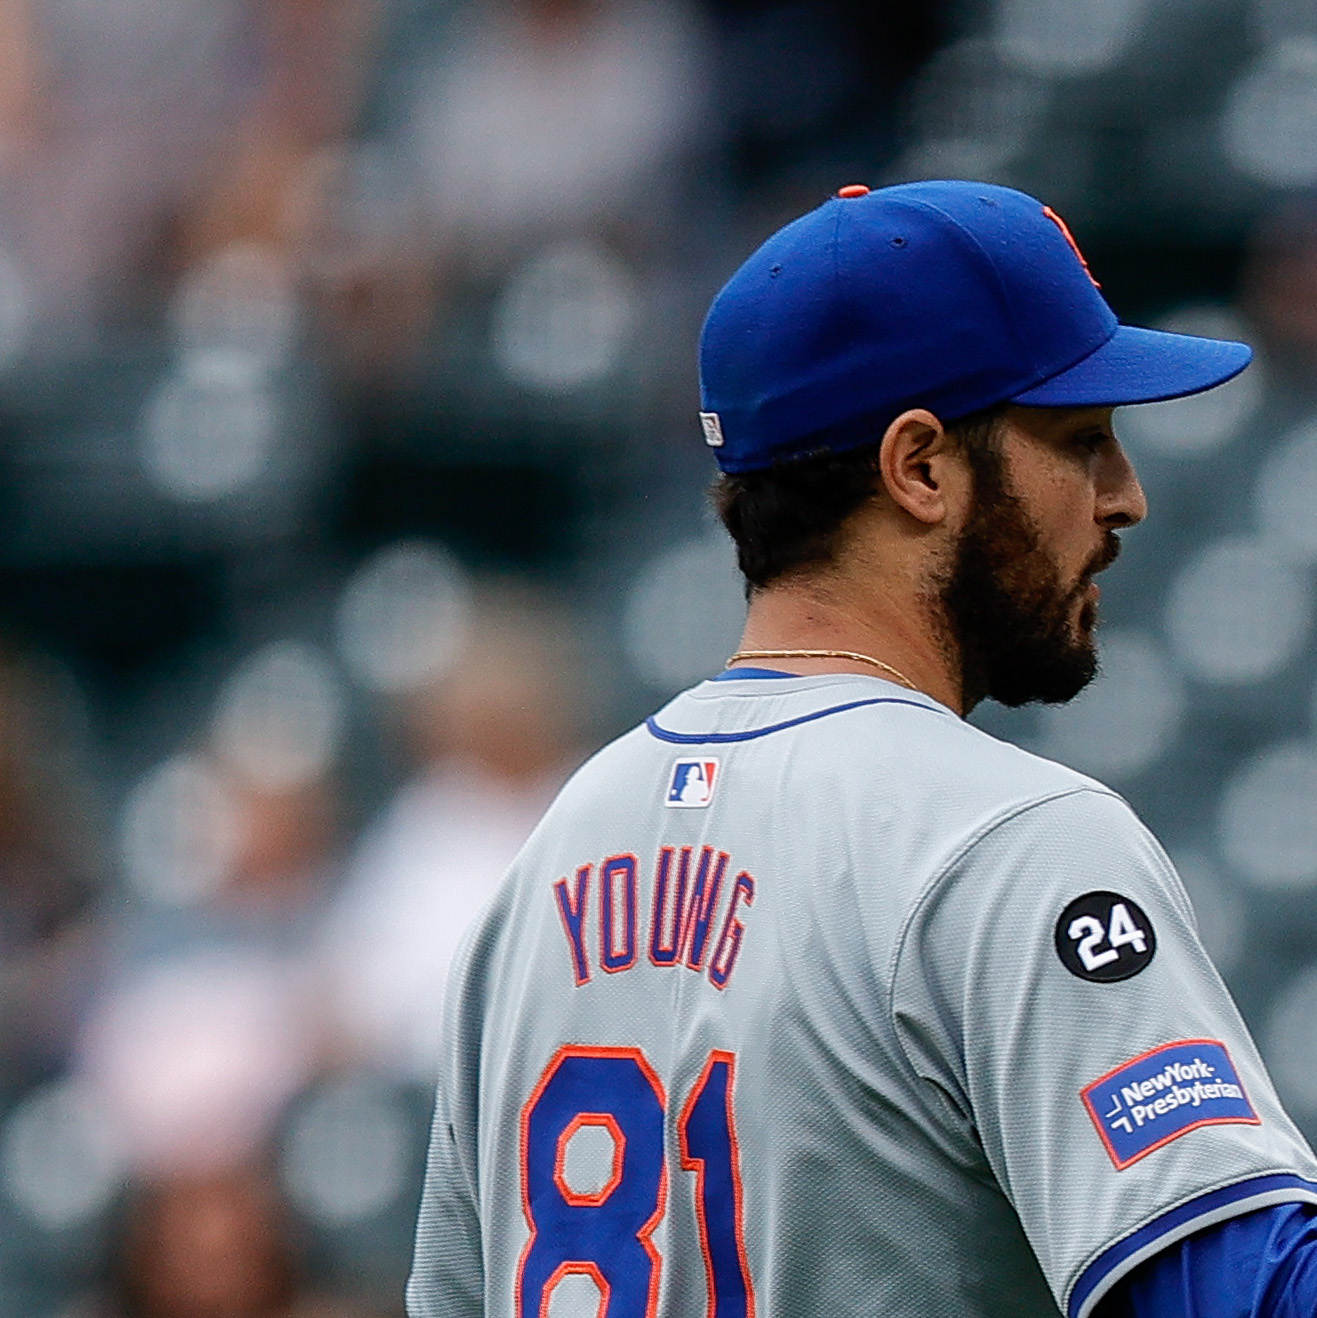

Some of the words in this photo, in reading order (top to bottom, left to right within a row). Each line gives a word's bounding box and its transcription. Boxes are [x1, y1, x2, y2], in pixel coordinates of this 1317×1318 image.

[553, 844, 756, 990] YOUNG
[1067, 903, 1148, 972] 24
[1130, 1078, 1244, 1127] Presbyterian
